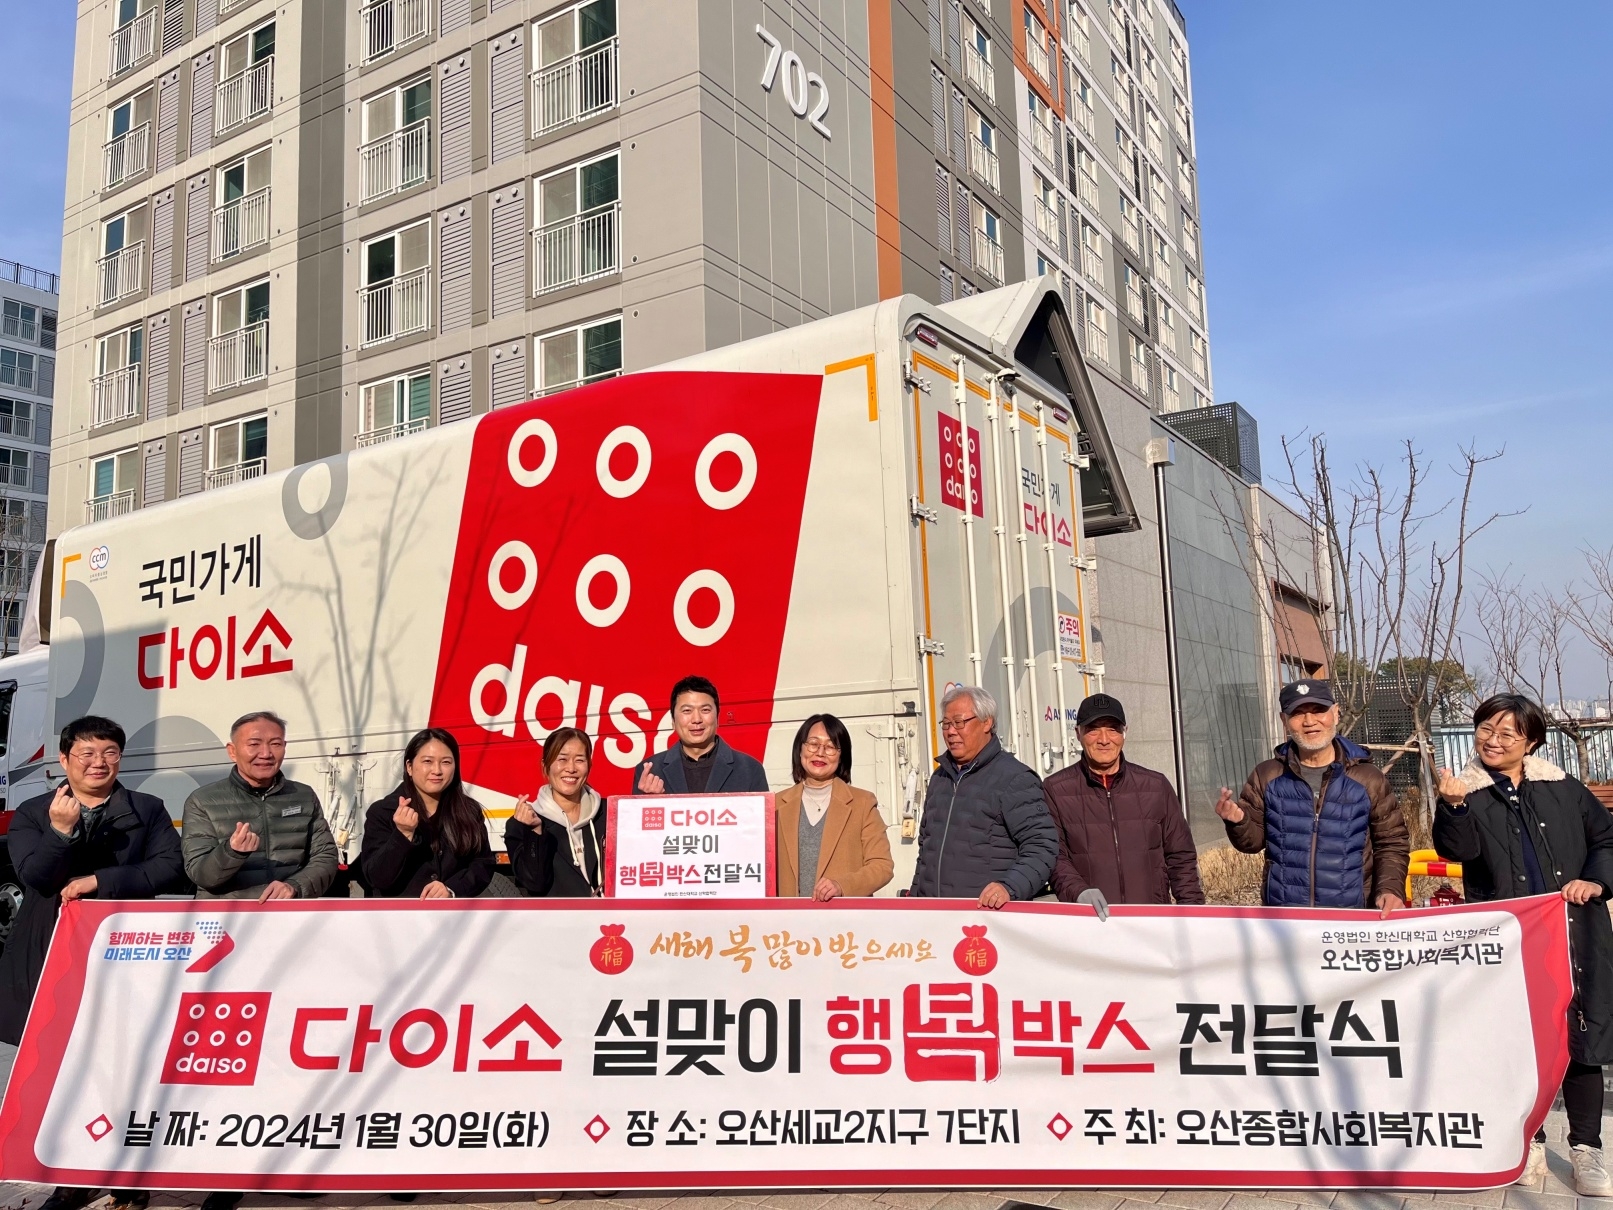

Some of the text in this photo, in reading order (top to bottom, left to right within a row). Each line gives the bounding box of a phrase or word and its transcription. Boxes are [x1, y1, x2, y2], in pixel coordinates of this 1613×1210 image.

[755, 23, 831, 141] 702
[945, 474, 979, 505] daio
[1021, 467, 1060, 507] 국민게
[92, 552, 107, 564] ccm
[138, 534, 261, 609] 국민가게
[1065, 617, 1080, 638] 주의
[137, 608, 294, 690] 다이소
[671, 809, 737, 826] 다이소
[663, 835, 718, 855] 설맞이
[109, 932, 194, 945] 함께하는 변화
[650, 925, 937, 972] 새해 복 많이 받으세요
[1321, 925, 1501, 944] 운영법인 한신대학교 산학협력단
[104, 948, 191, 960] 미래도시 오산
[600, 947, 623, 967] 福
[963, 948, 988, 969] 福
[1321, 942, 1503, 972] 오산종합사회복지관
[290, 1004, 562, 1072] 다이소
[593, 999, 800, 1075] 설맞이
[1177, 1000, 1402, 1078] 전달식
[174, 1051, 248, 1075] daiso
[124, 1111, 160, 1147] 날
[216, 1113, 345, 1149] 2024년
[356, 1113, 401, 1149] 1월
[410, 1111, 549, 1148] 30일(화)
[627, 1111, 658, 1146] 장
[716, 1109, 929, 1145] 오산세교2지구
[937, 1109, 1020, 1145] 7단지
[1085, 1110, 1116, 1145] 주
[1177, 1110, 1484, 1148] 오산종합사회복지관
